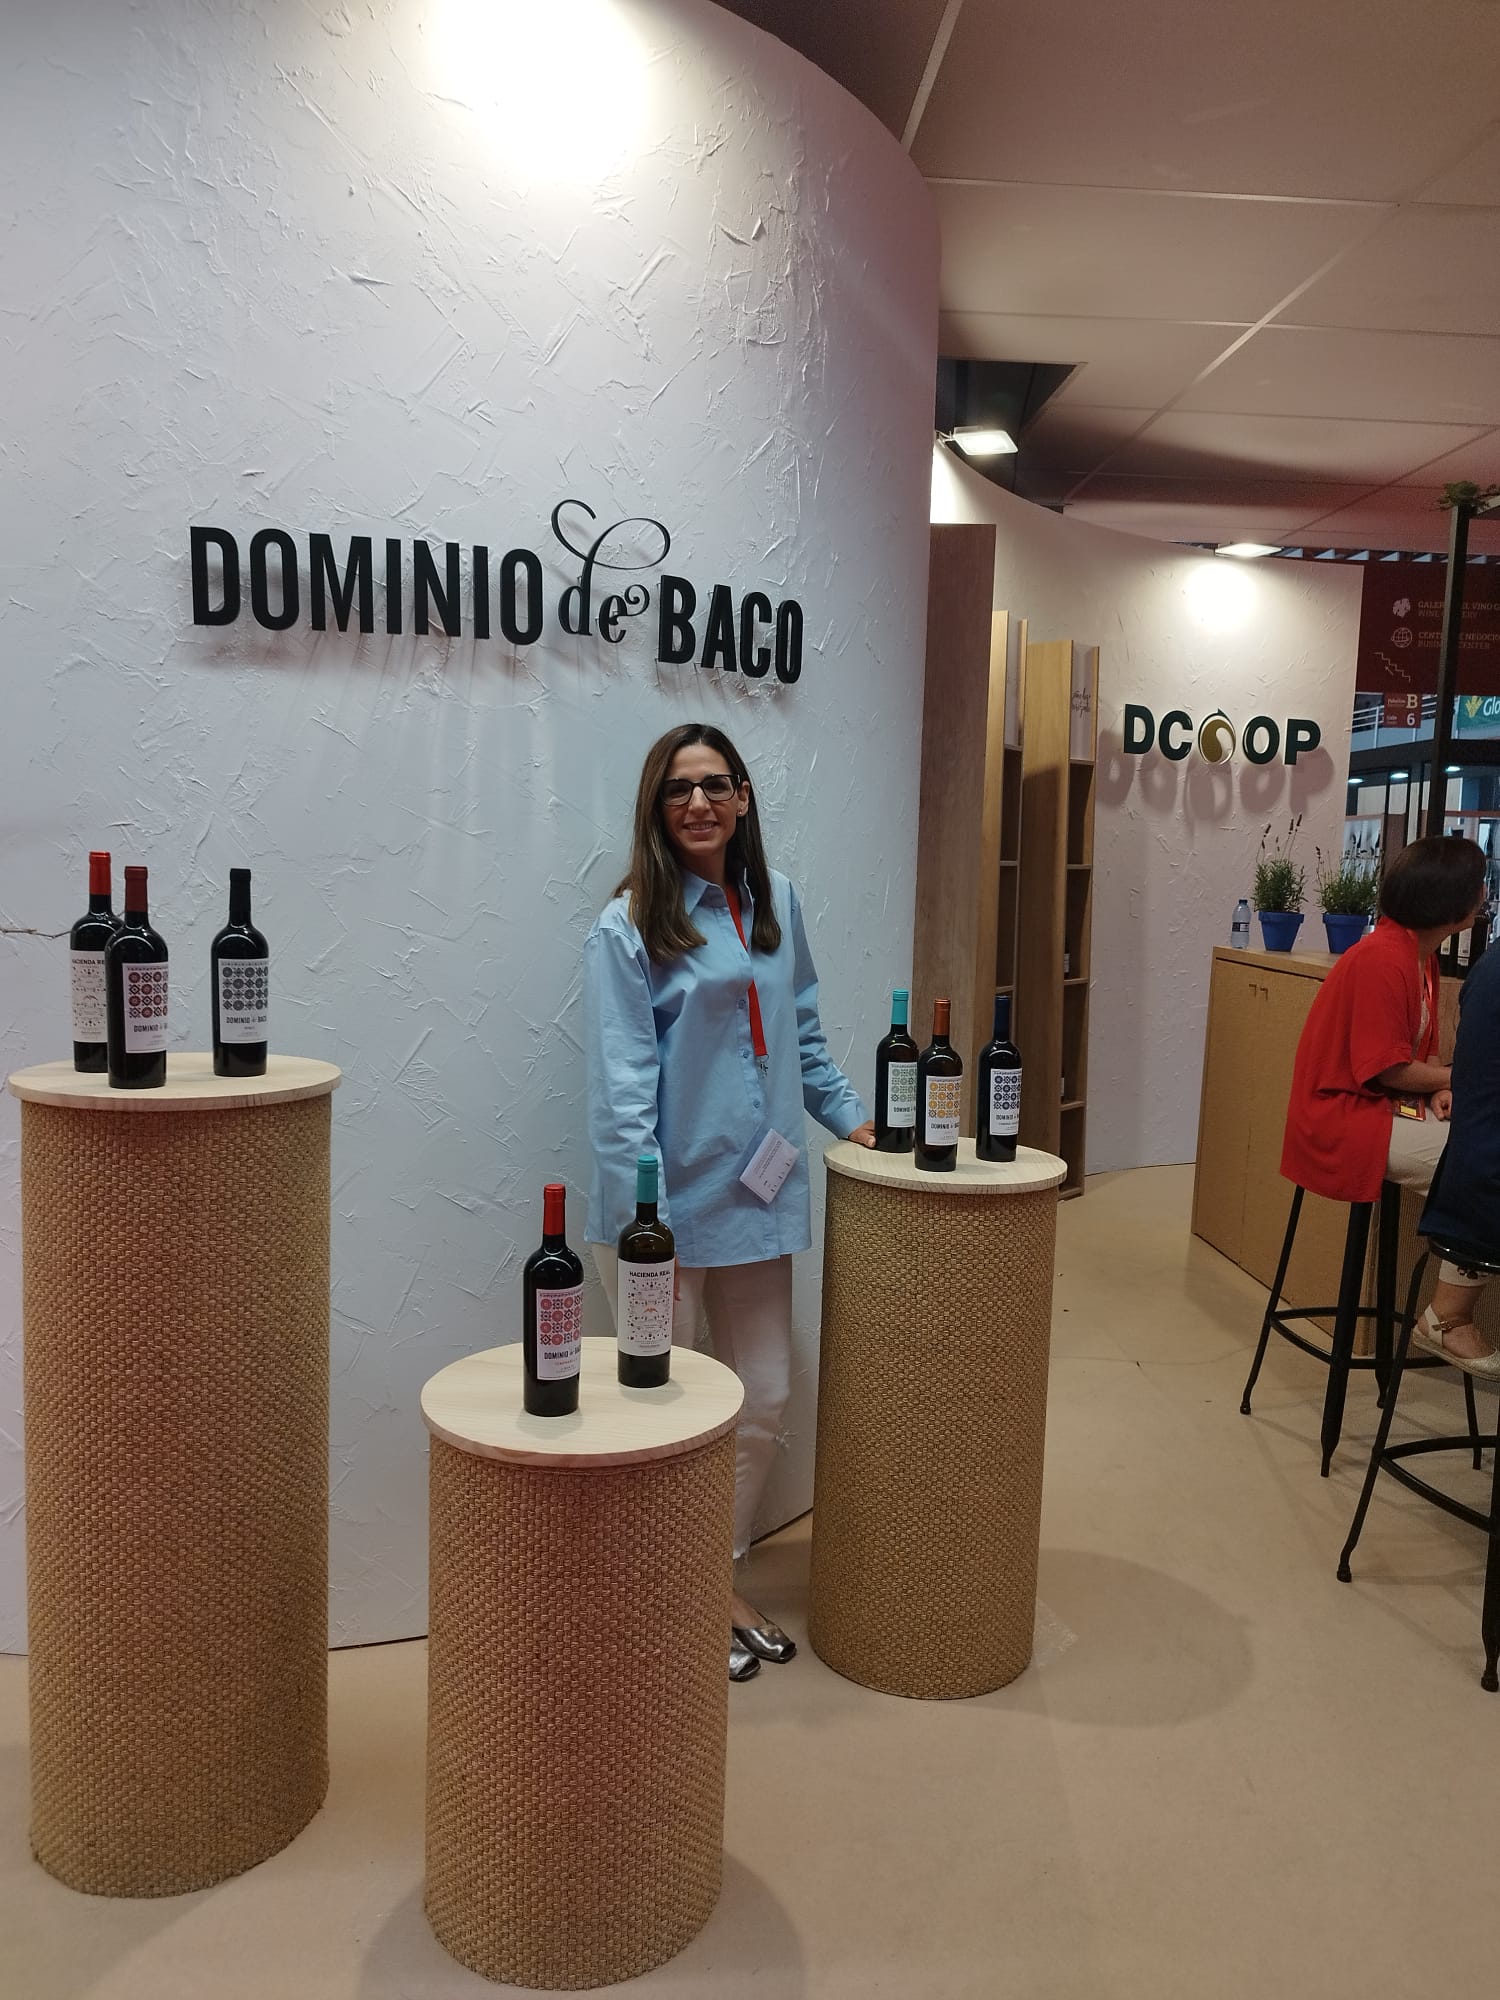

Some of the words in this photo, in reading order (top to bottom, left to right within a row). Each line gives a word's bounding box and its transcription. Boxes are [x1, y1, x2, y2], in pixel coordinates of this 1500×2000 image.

[190, 526, 543, 645] DOMINIO
[551, 499, 671, 643] de
[658, 574, 804, 684] BACO
[1406, 694, 1418, 709] B
[1407, 713, 1416, 726] 6
[544, 1350, 569, 1360] DOMINIO
